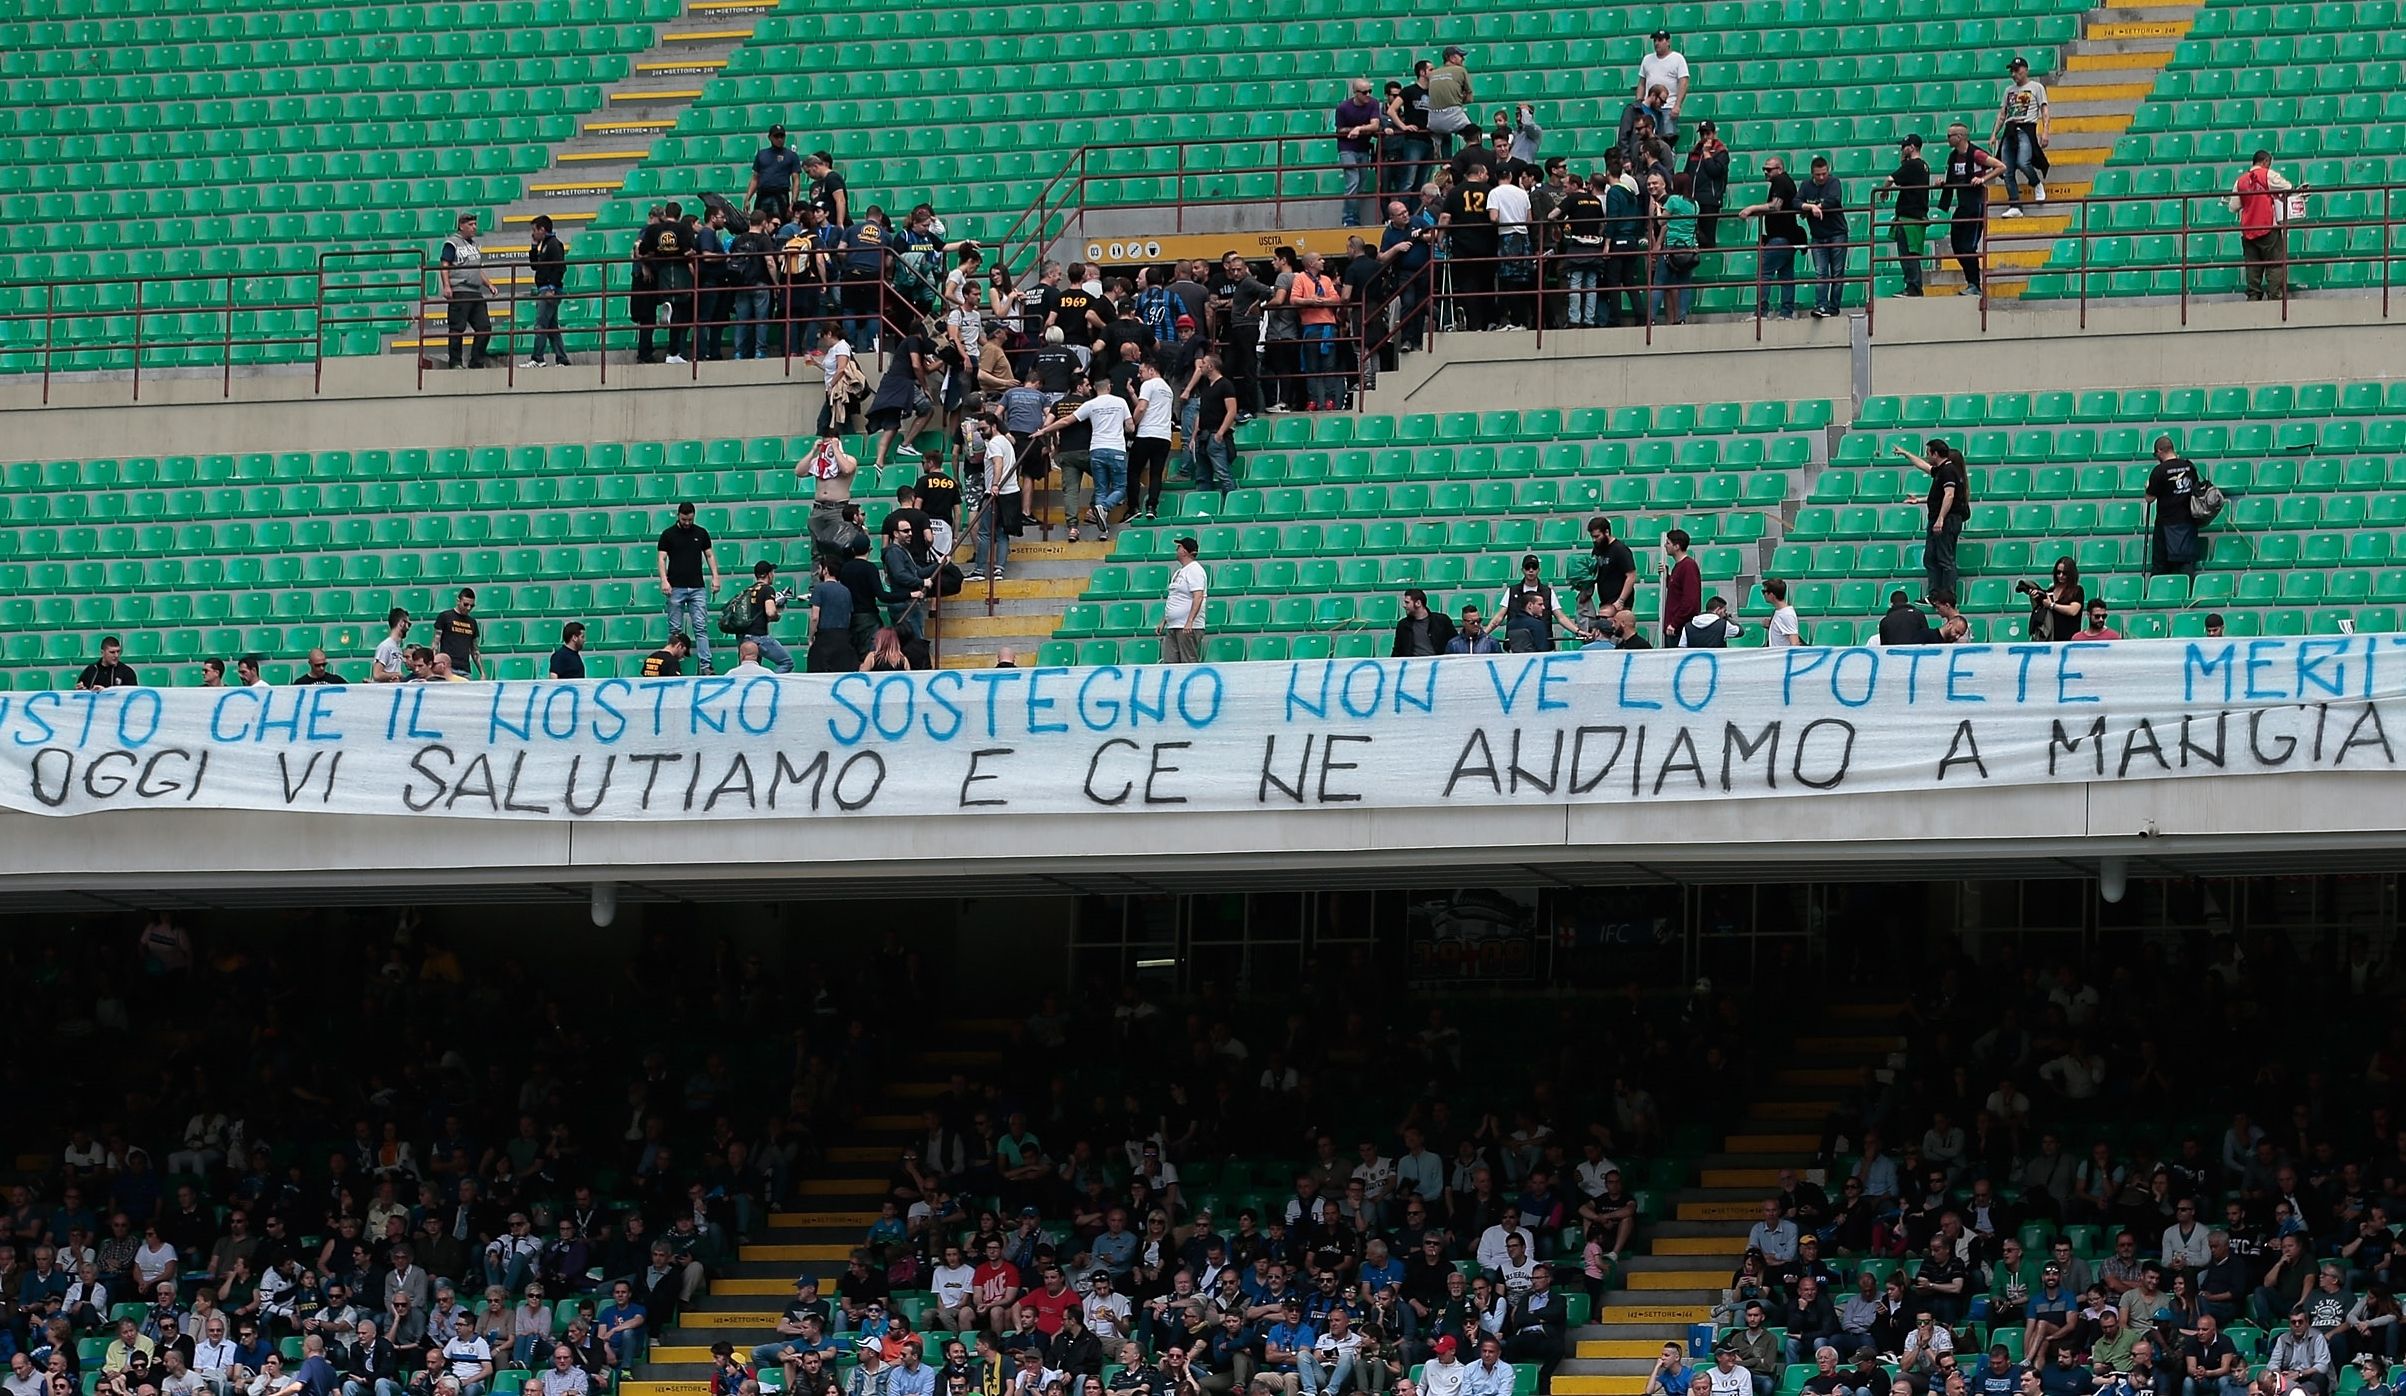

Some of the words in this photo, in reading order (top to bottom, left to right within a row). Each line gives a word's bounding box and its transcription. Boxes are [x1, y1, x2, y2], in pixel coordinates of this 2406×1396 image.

[668, 67, 697, 75] SETTORE
[1462, 190, 1484, 212] 12
[1258, 236, 1283, 246] USCITA
[1060, 297, 1087, 307] 1969
[928, 478, 954, 489] 1969
[0, 688, 163, 749] STO
[210, 686, 347, 743] CHE
[386, 687, 443, 741] IL
[488, 672, 780, 745] NOSTRO
[827, 665, 1225, 745] SOSTEGNO
[1285, 660, 1439, 722] NON
[1487, 653, 1584, 715] VE
[1618, 652, 1719, 713] LO
[1783, 643, 2111, 708] POTETE
[31, 748, 208, 807] OGGI
[278, 751, 342, 803] VI
[404, 745, 887, 815] SALUTIAMO
[960, 748, 1014, 807] E
[1084, 739, 1192, 805] CE
[1259, 734, 1372, 803] NE
[1443, 719, 1855, 796] ANDIAMO
[1938, 720, 1988, 780] A
[2049, 702, 2394, 778] MANGIA
[1600, 922, 1633, 944] IFC
[983, 1271, 1006, 1299] NIKE
[2310, 1300, 2324, 1314] LAS
[2326, 1299, 2344, 1315] VEGAS
[670, 1385, 702, 1393] SETTORE
